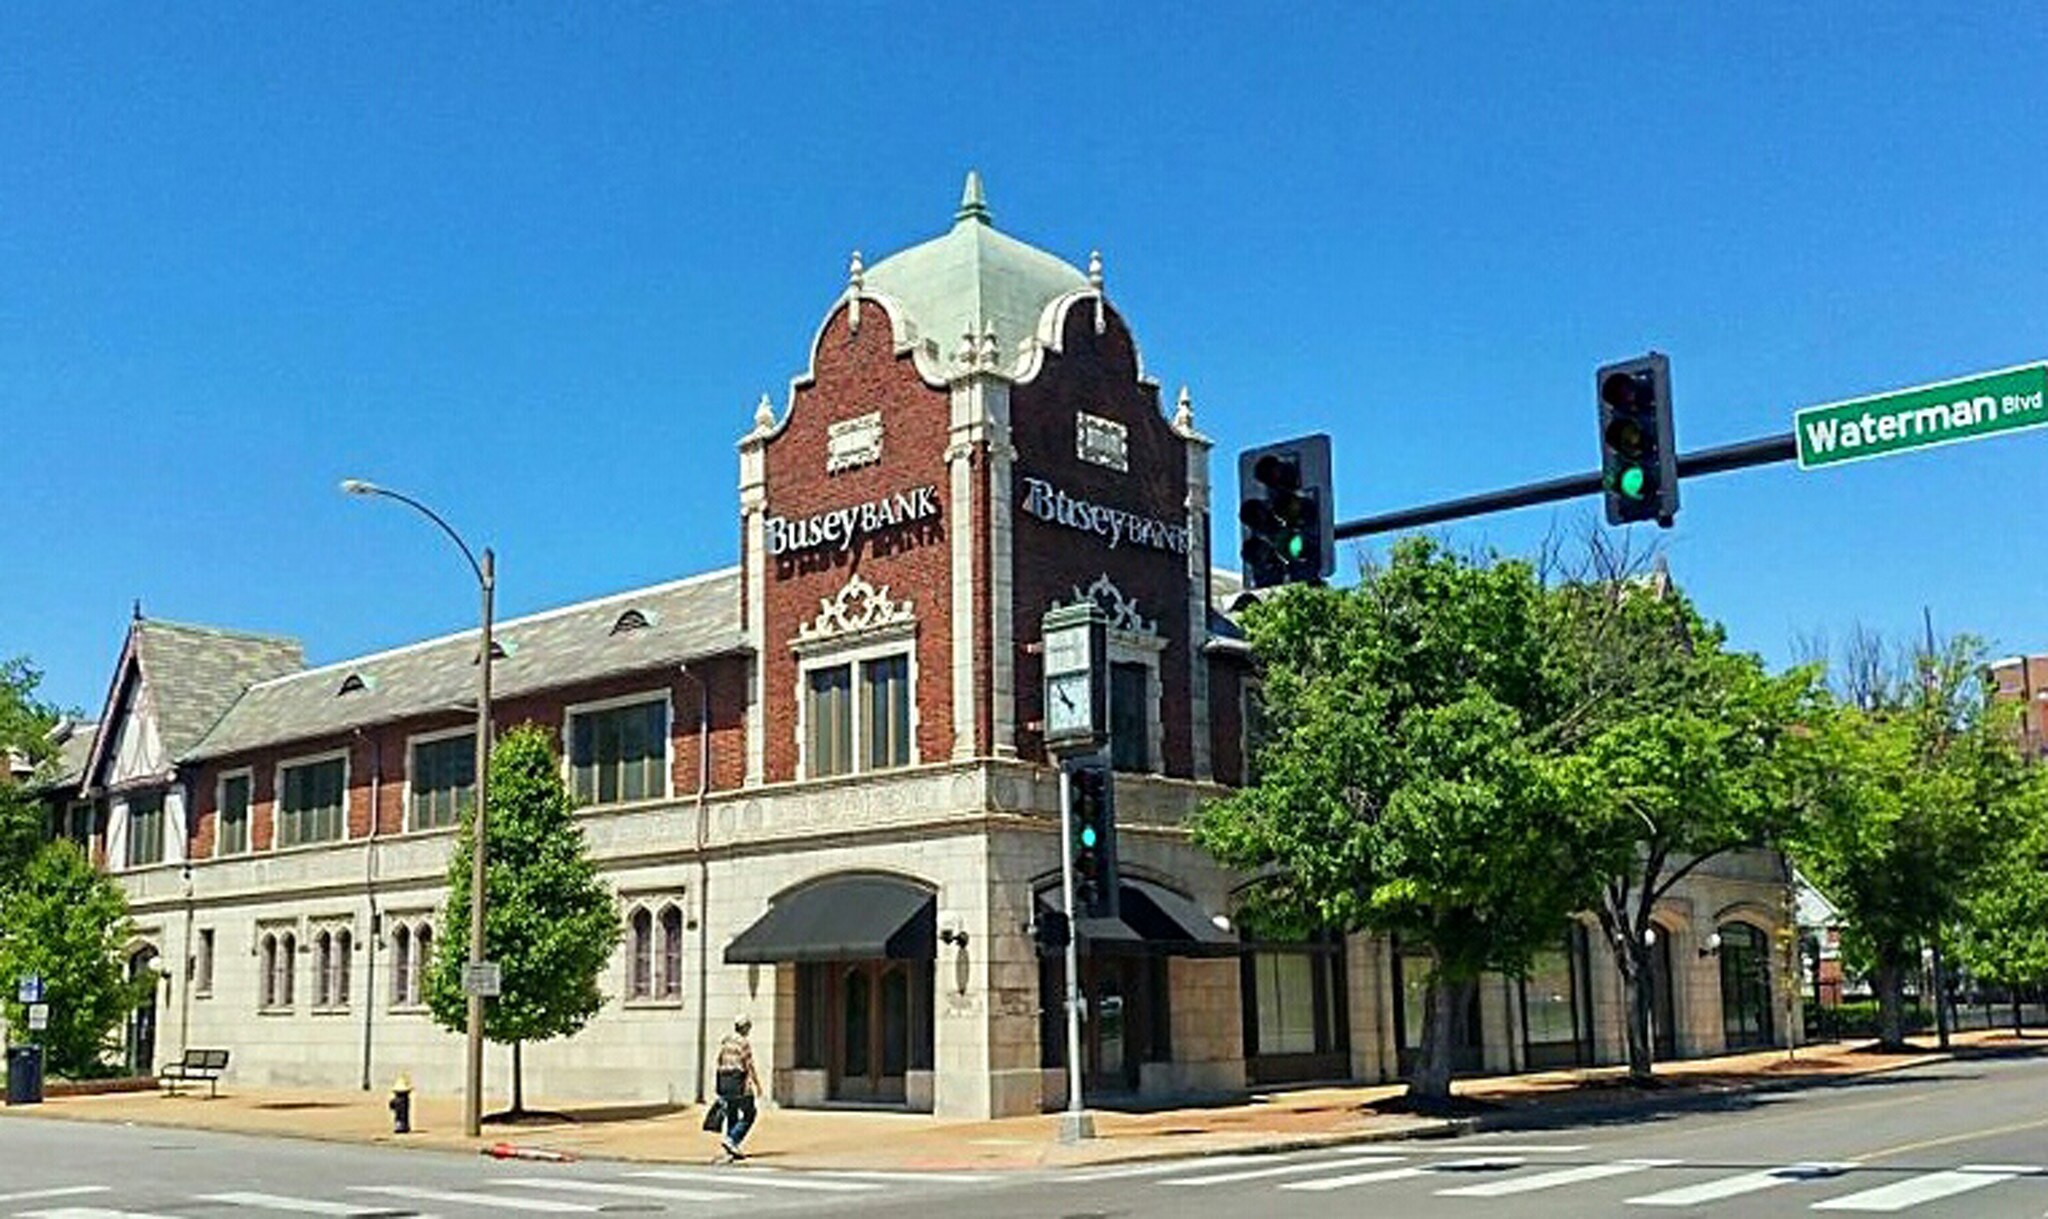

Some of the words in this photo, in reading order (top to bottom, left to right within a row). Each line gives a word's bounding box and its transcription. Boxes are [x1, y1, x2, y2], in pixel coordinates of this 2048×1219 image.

[1806, 396, 1997, 453] Waterman
[2002, 391, 2043, 414] Blvd
[765, 507, 859, 554] Busey
[861, 485, 936, 532] BANK
[1023, 477, 1127, 549] Busey
